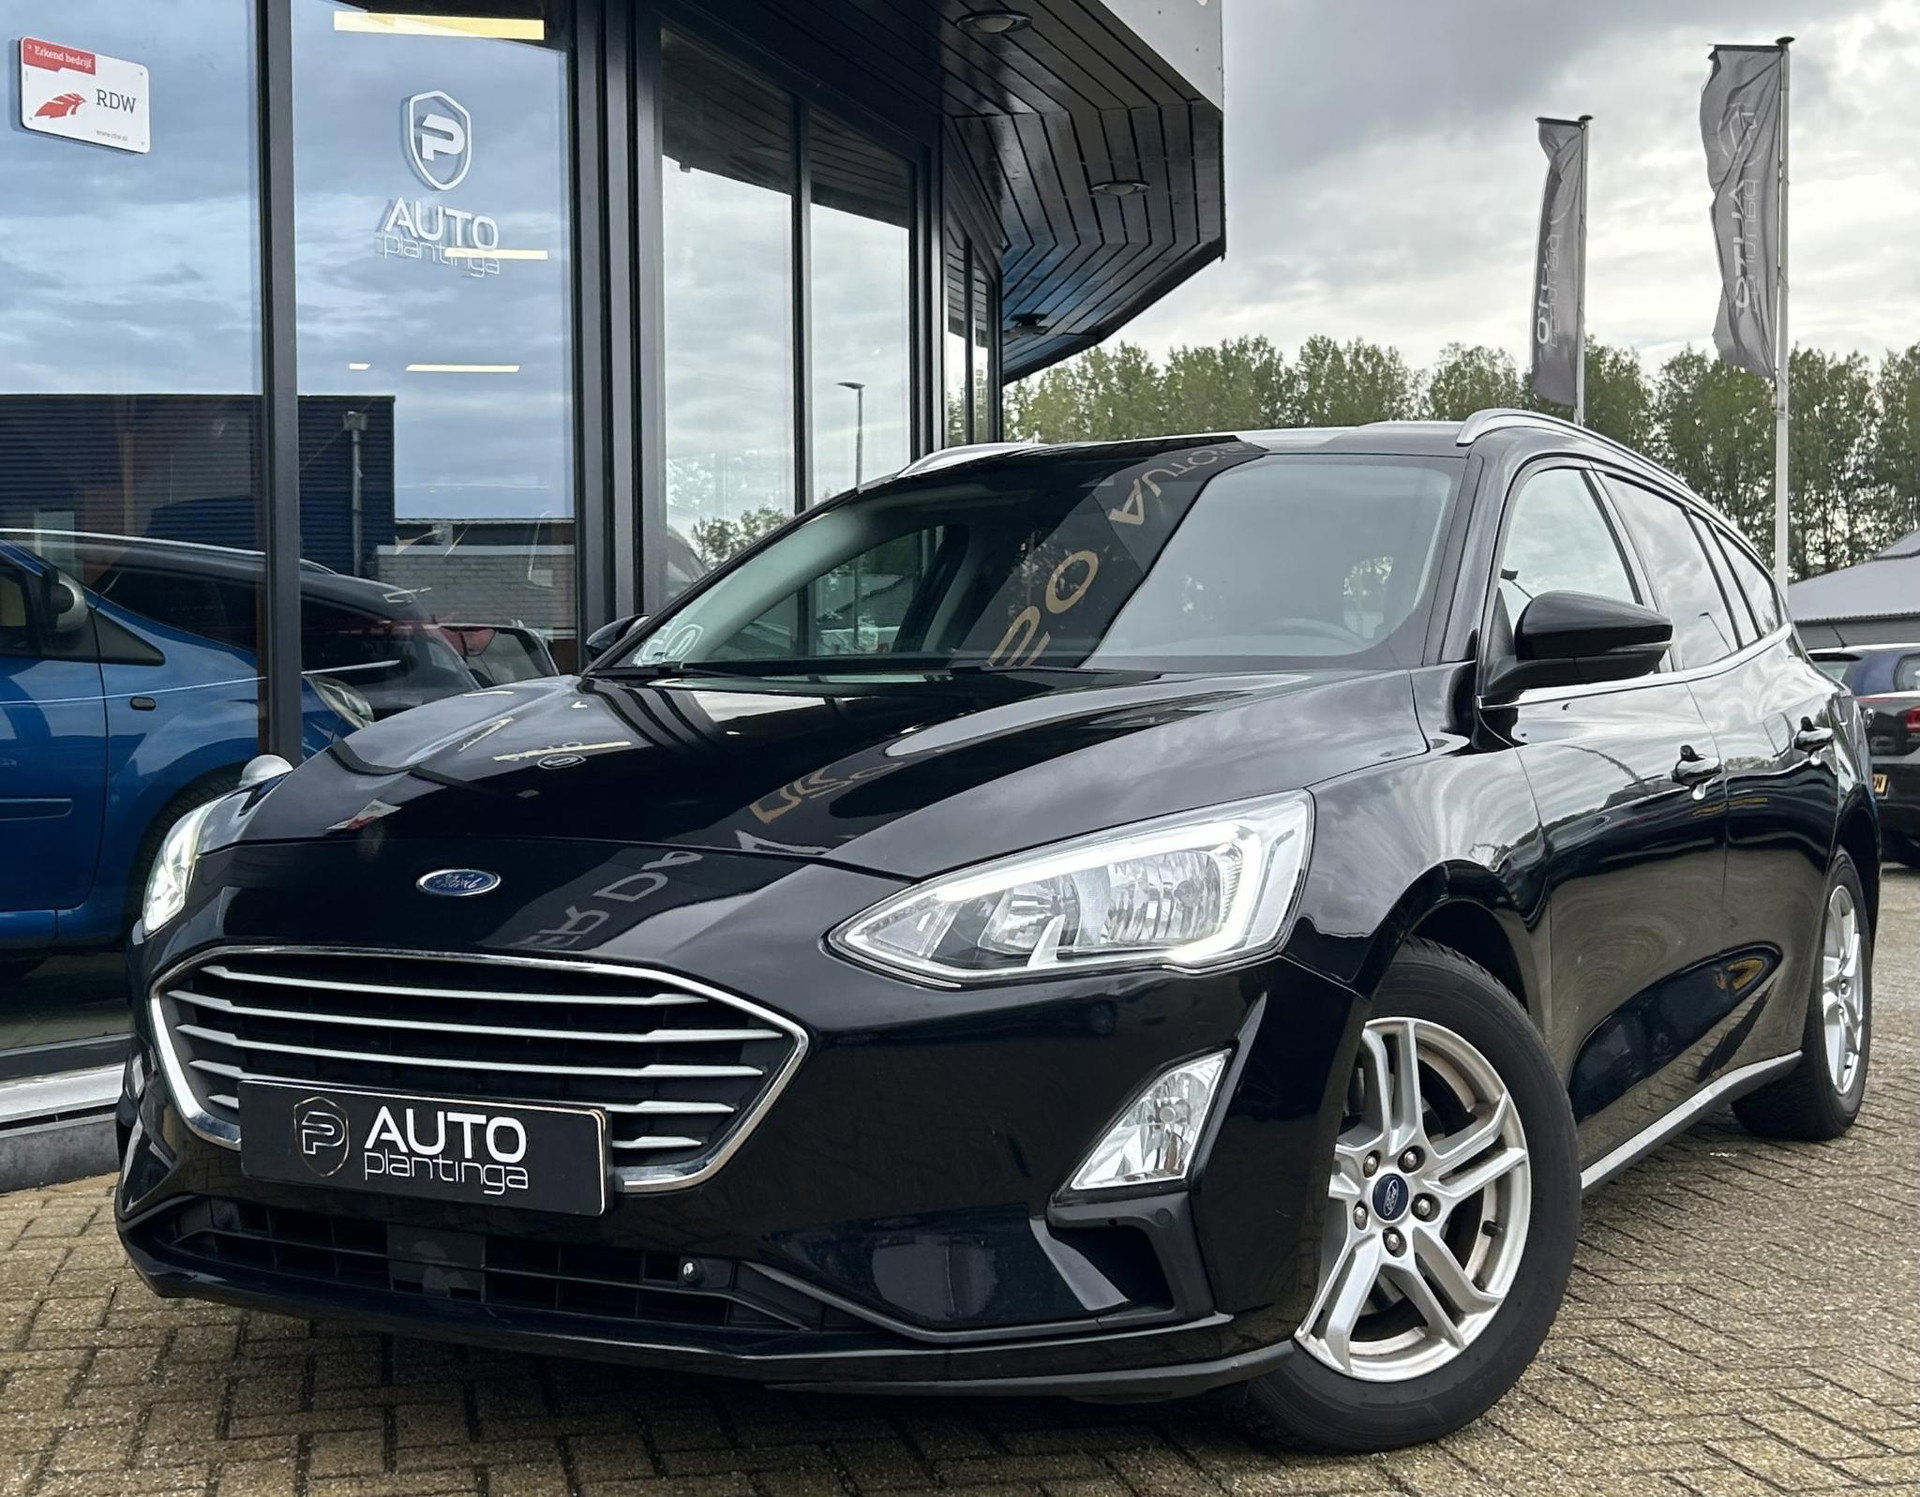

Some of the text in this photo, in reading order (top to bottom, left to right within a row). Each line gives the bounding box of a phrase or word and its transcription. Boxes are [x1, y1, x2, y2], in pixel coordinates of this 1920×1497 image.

[34, 45, 65, 61] Erkend
[96, 88, 137, 114] RDW
[384, 197, 500, 250] AUTO
[363, 1105, 528, 1163] AUTO
[363, 1151, 529, 1195] plantinga
